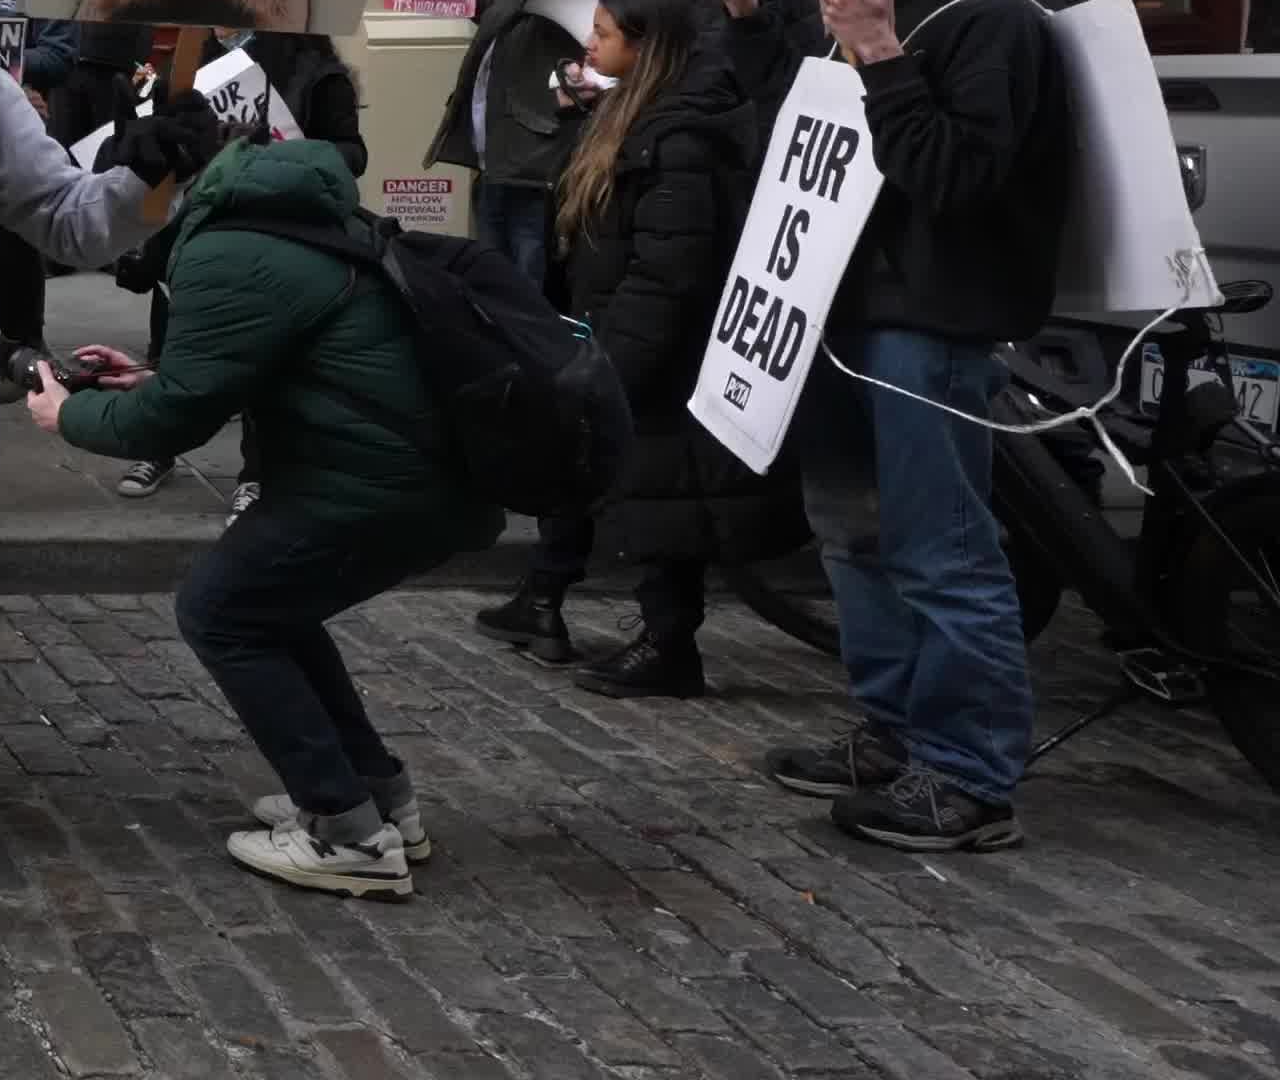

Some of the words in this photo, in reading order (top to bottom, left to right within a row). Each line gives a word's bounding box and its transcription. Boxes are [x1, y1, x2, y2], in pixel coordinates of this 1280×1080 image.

[386, 181, 449, 193] DANGER
[779, 114, 860, 203] FUR
[386, 206, 447, 214] SIDEWALK
[766, 204, 811, 282] IS
[716, 275, 808, 382] DEAD
